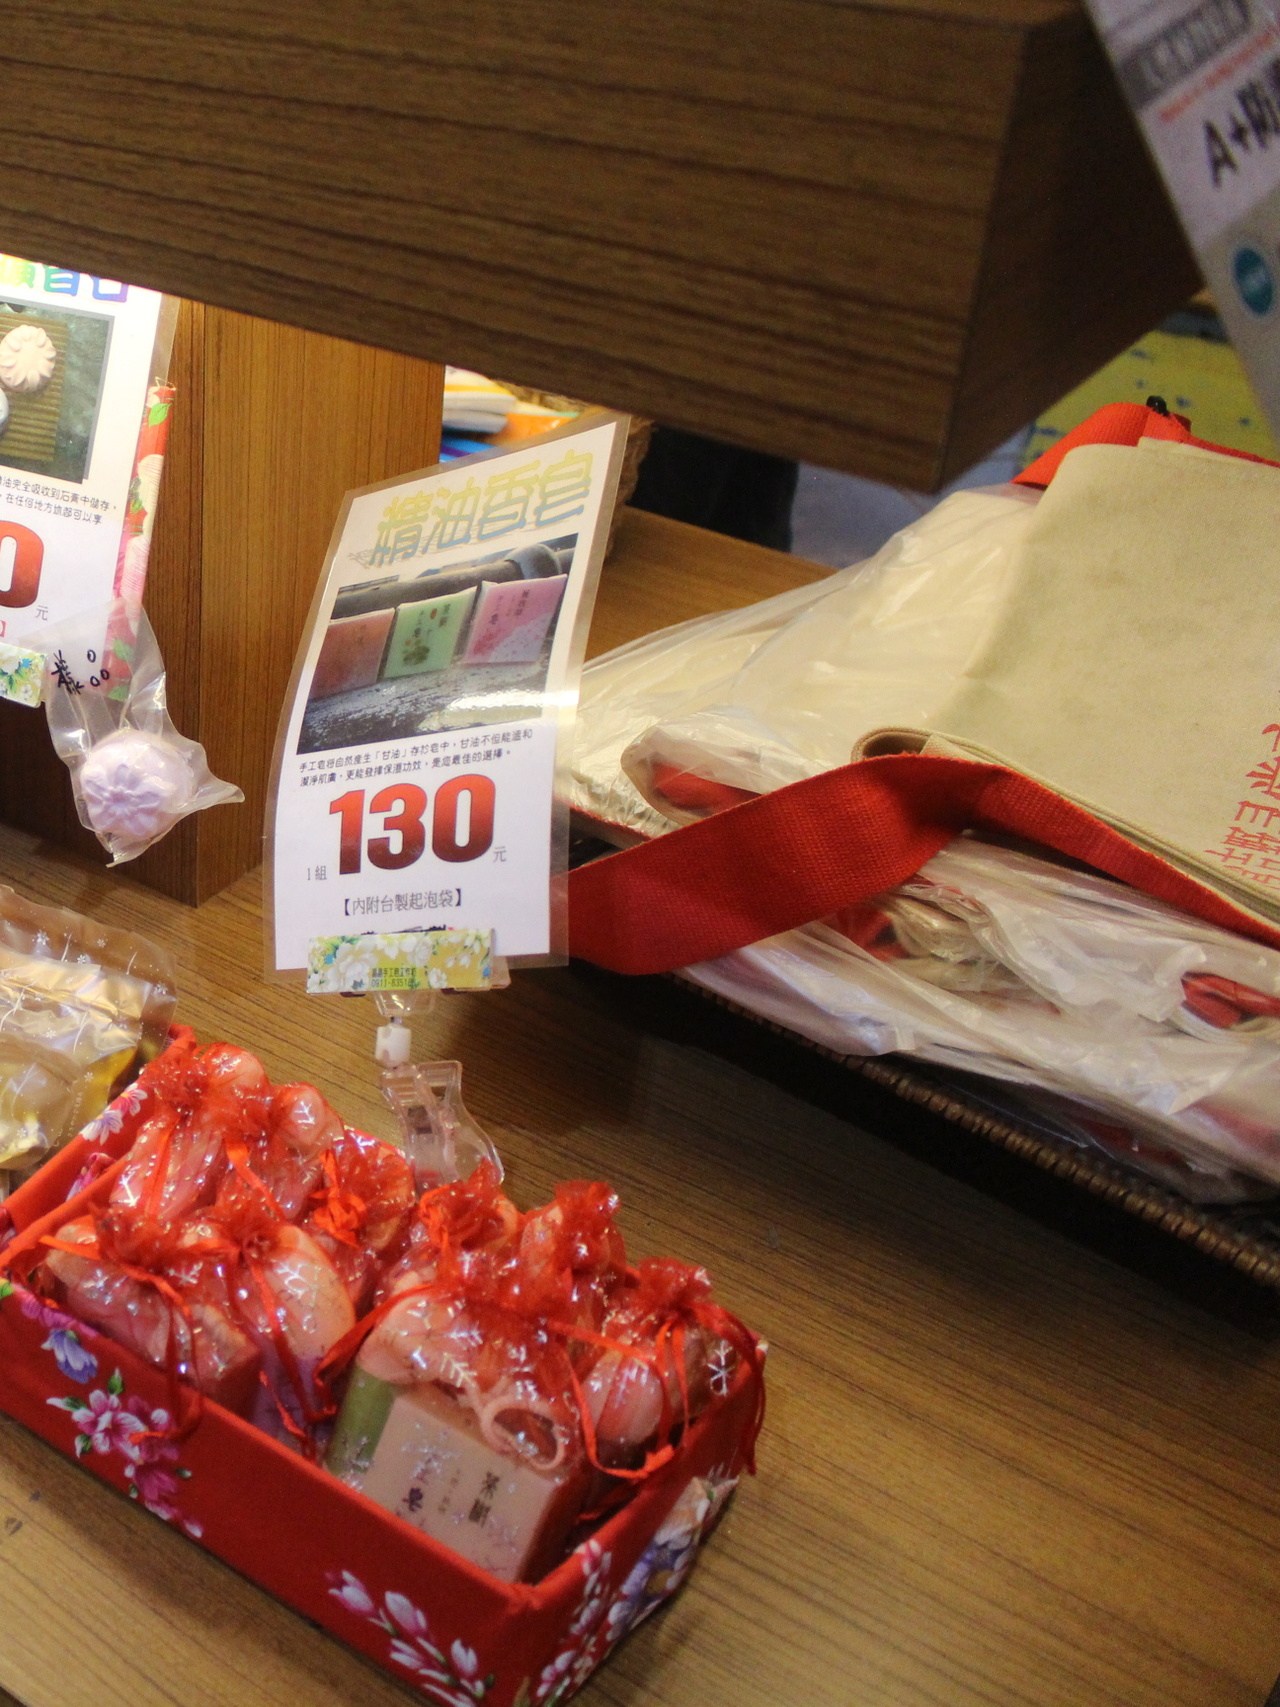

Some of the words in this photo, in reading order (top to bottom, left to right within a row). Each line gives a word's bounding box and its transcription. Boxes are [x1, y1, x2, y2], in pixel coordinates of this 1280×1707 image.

[368, 448, 594, 568] 精油香皂
[35, 604, 49, 622] 元
[328, 772, 497, 876] 130
[492, 846, 507, 863] 元
